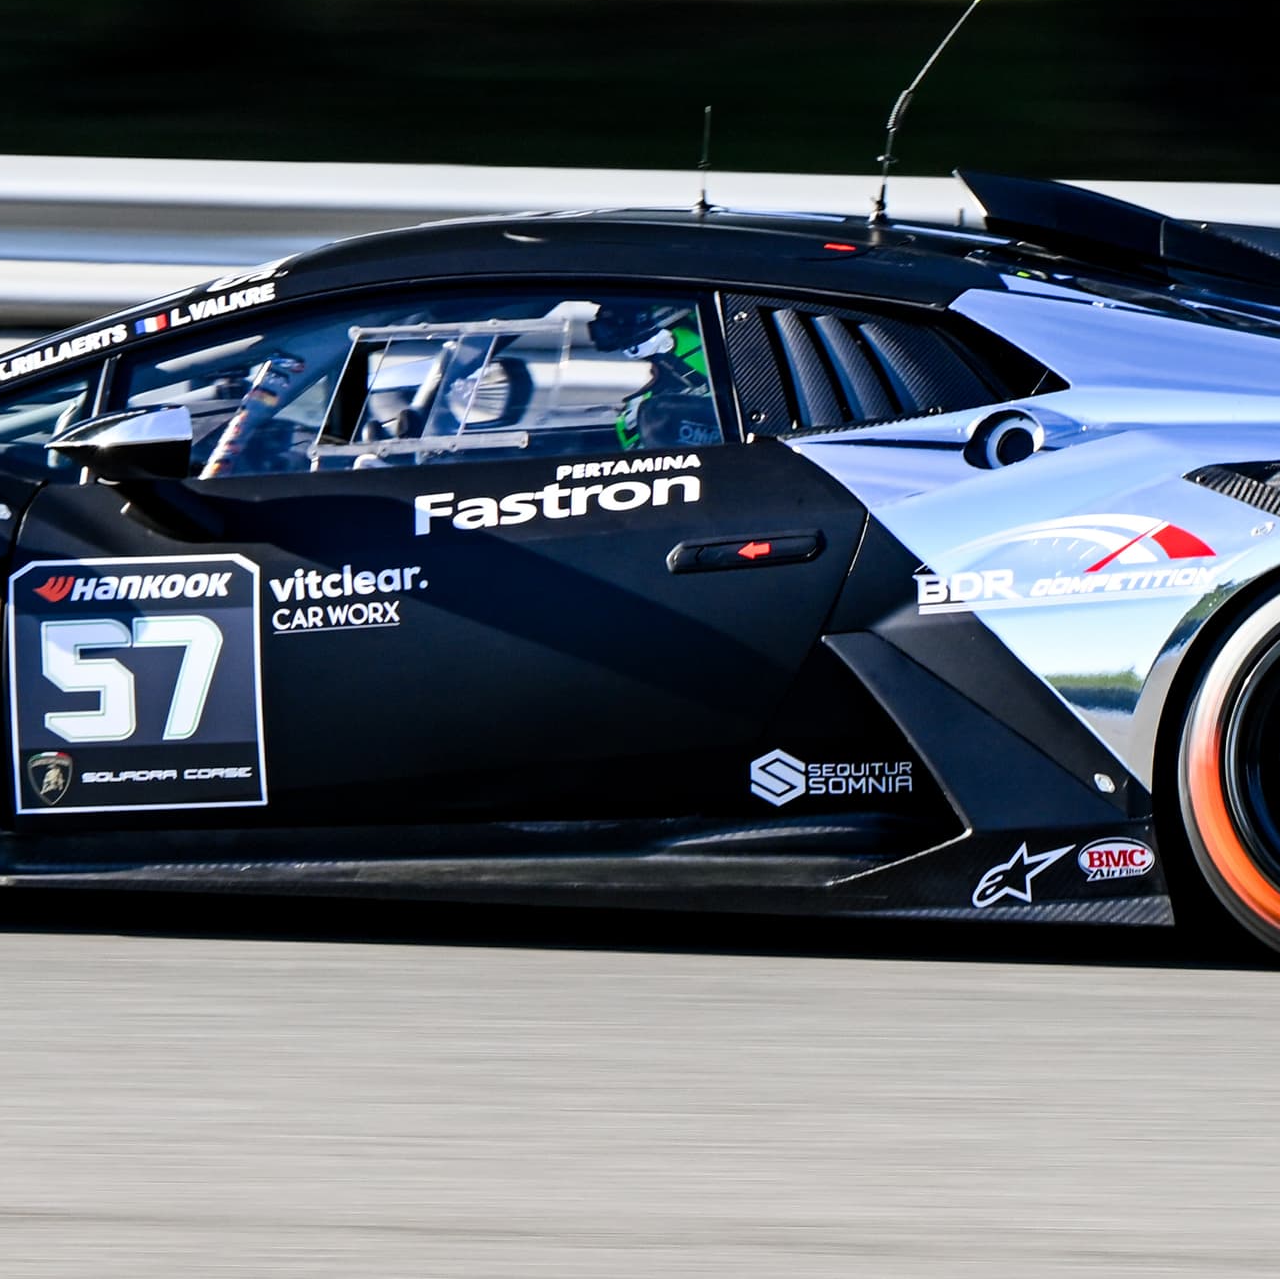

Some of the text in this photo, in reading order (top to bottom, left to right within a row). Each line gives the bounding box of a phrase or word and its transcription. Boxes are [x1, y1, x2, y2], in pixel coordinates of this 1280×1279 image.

[556, 454, 701, 481] PERTAMINA
[414, 475, 701, 536] Fastron
[269, 564, 429, 603] vitclear.
[912, 567, 1218, 605] BDR COMPETITION
[272, 600, 401, 630] CAR WORX
[40, 614, 224, 743] 57
[81, 766, 253, 784] SQUADRA CORSE
[807, 761, 913, 778] SEQUITUR
[808, 775, 913, 795] SOMNIA
[1087, 848, 1147, 868] BMC
[1091, 868, 1117, 879] Air
